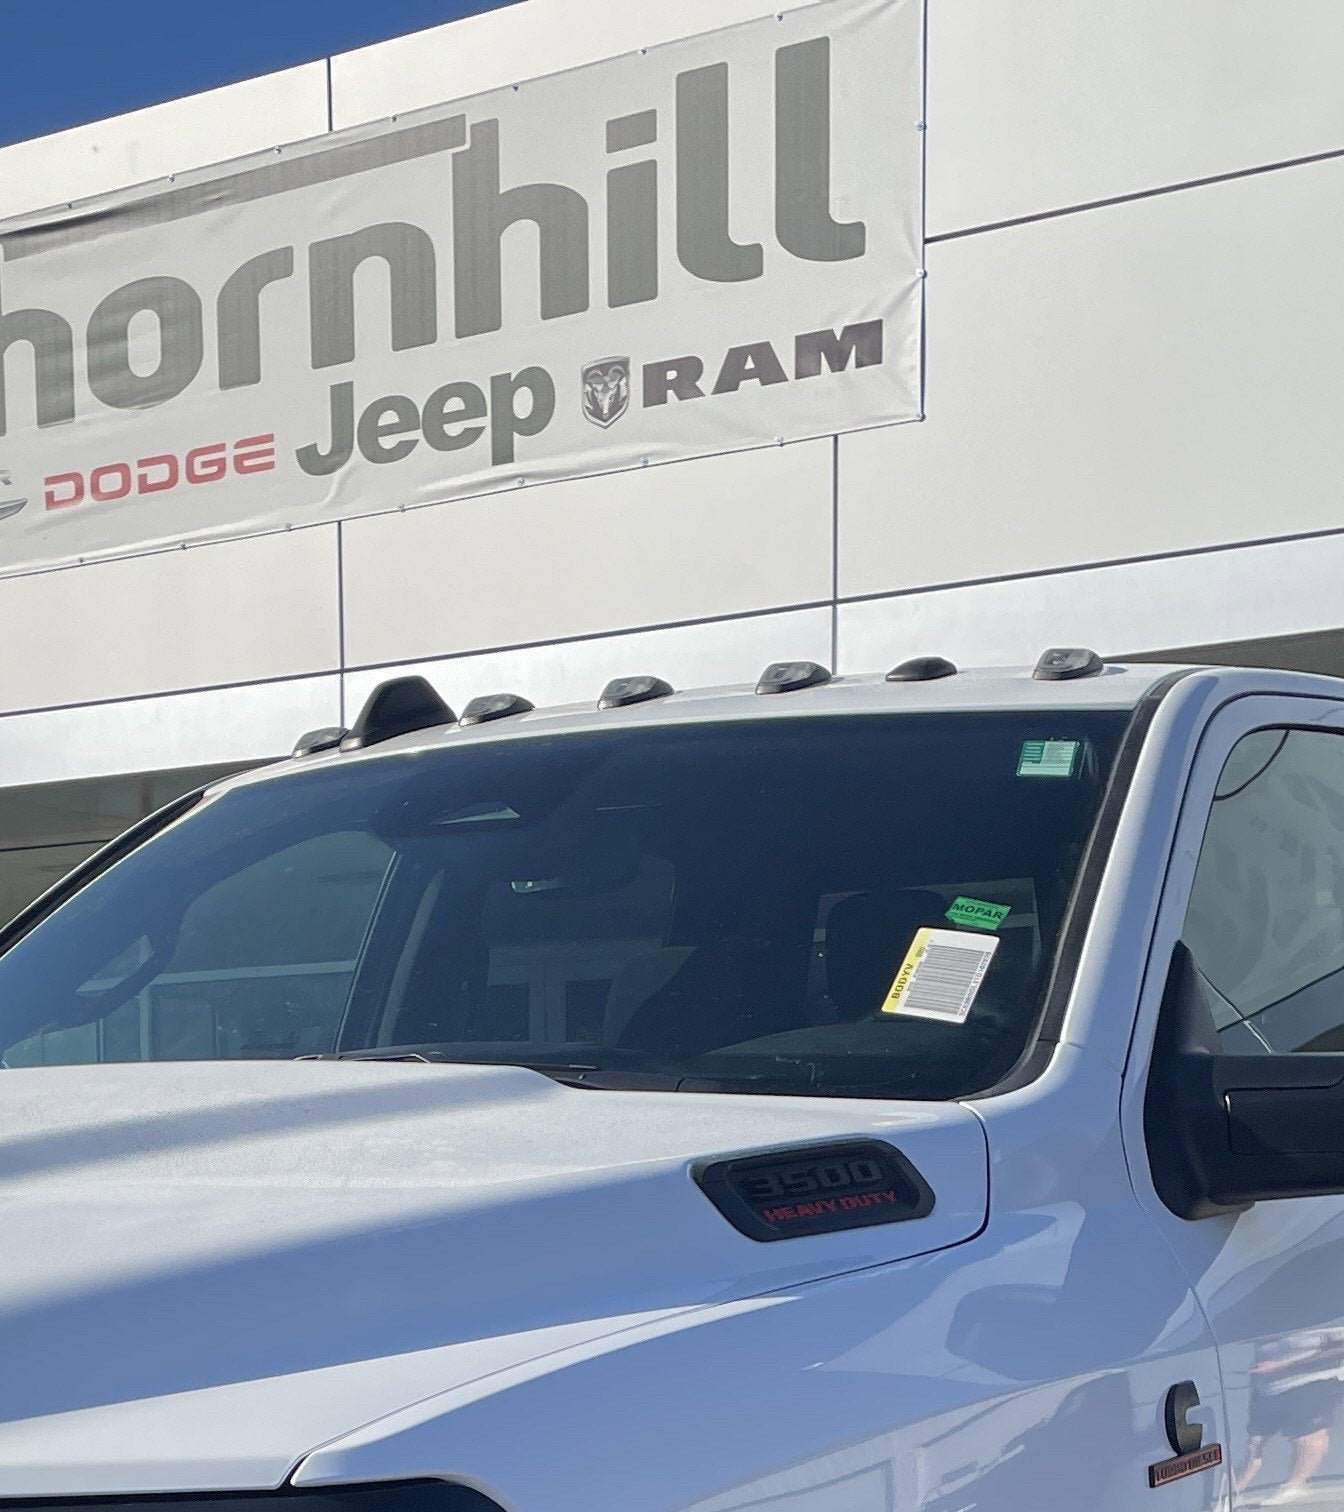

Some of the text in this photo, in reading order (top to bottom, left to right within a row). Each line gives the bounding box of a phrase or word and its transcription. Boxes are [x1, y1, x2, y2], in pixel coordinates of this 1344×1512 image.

[44, 433, 276, 512] DODGE
[295, 365, 556, 478] Jeep
[642, 318, 884, 408] RAM
[952, 903, 1004, 920] MOPAR
[745, 1160, 883, 1198] 3500
[763, 1190, 897, 1222] HEAVY DUTY
